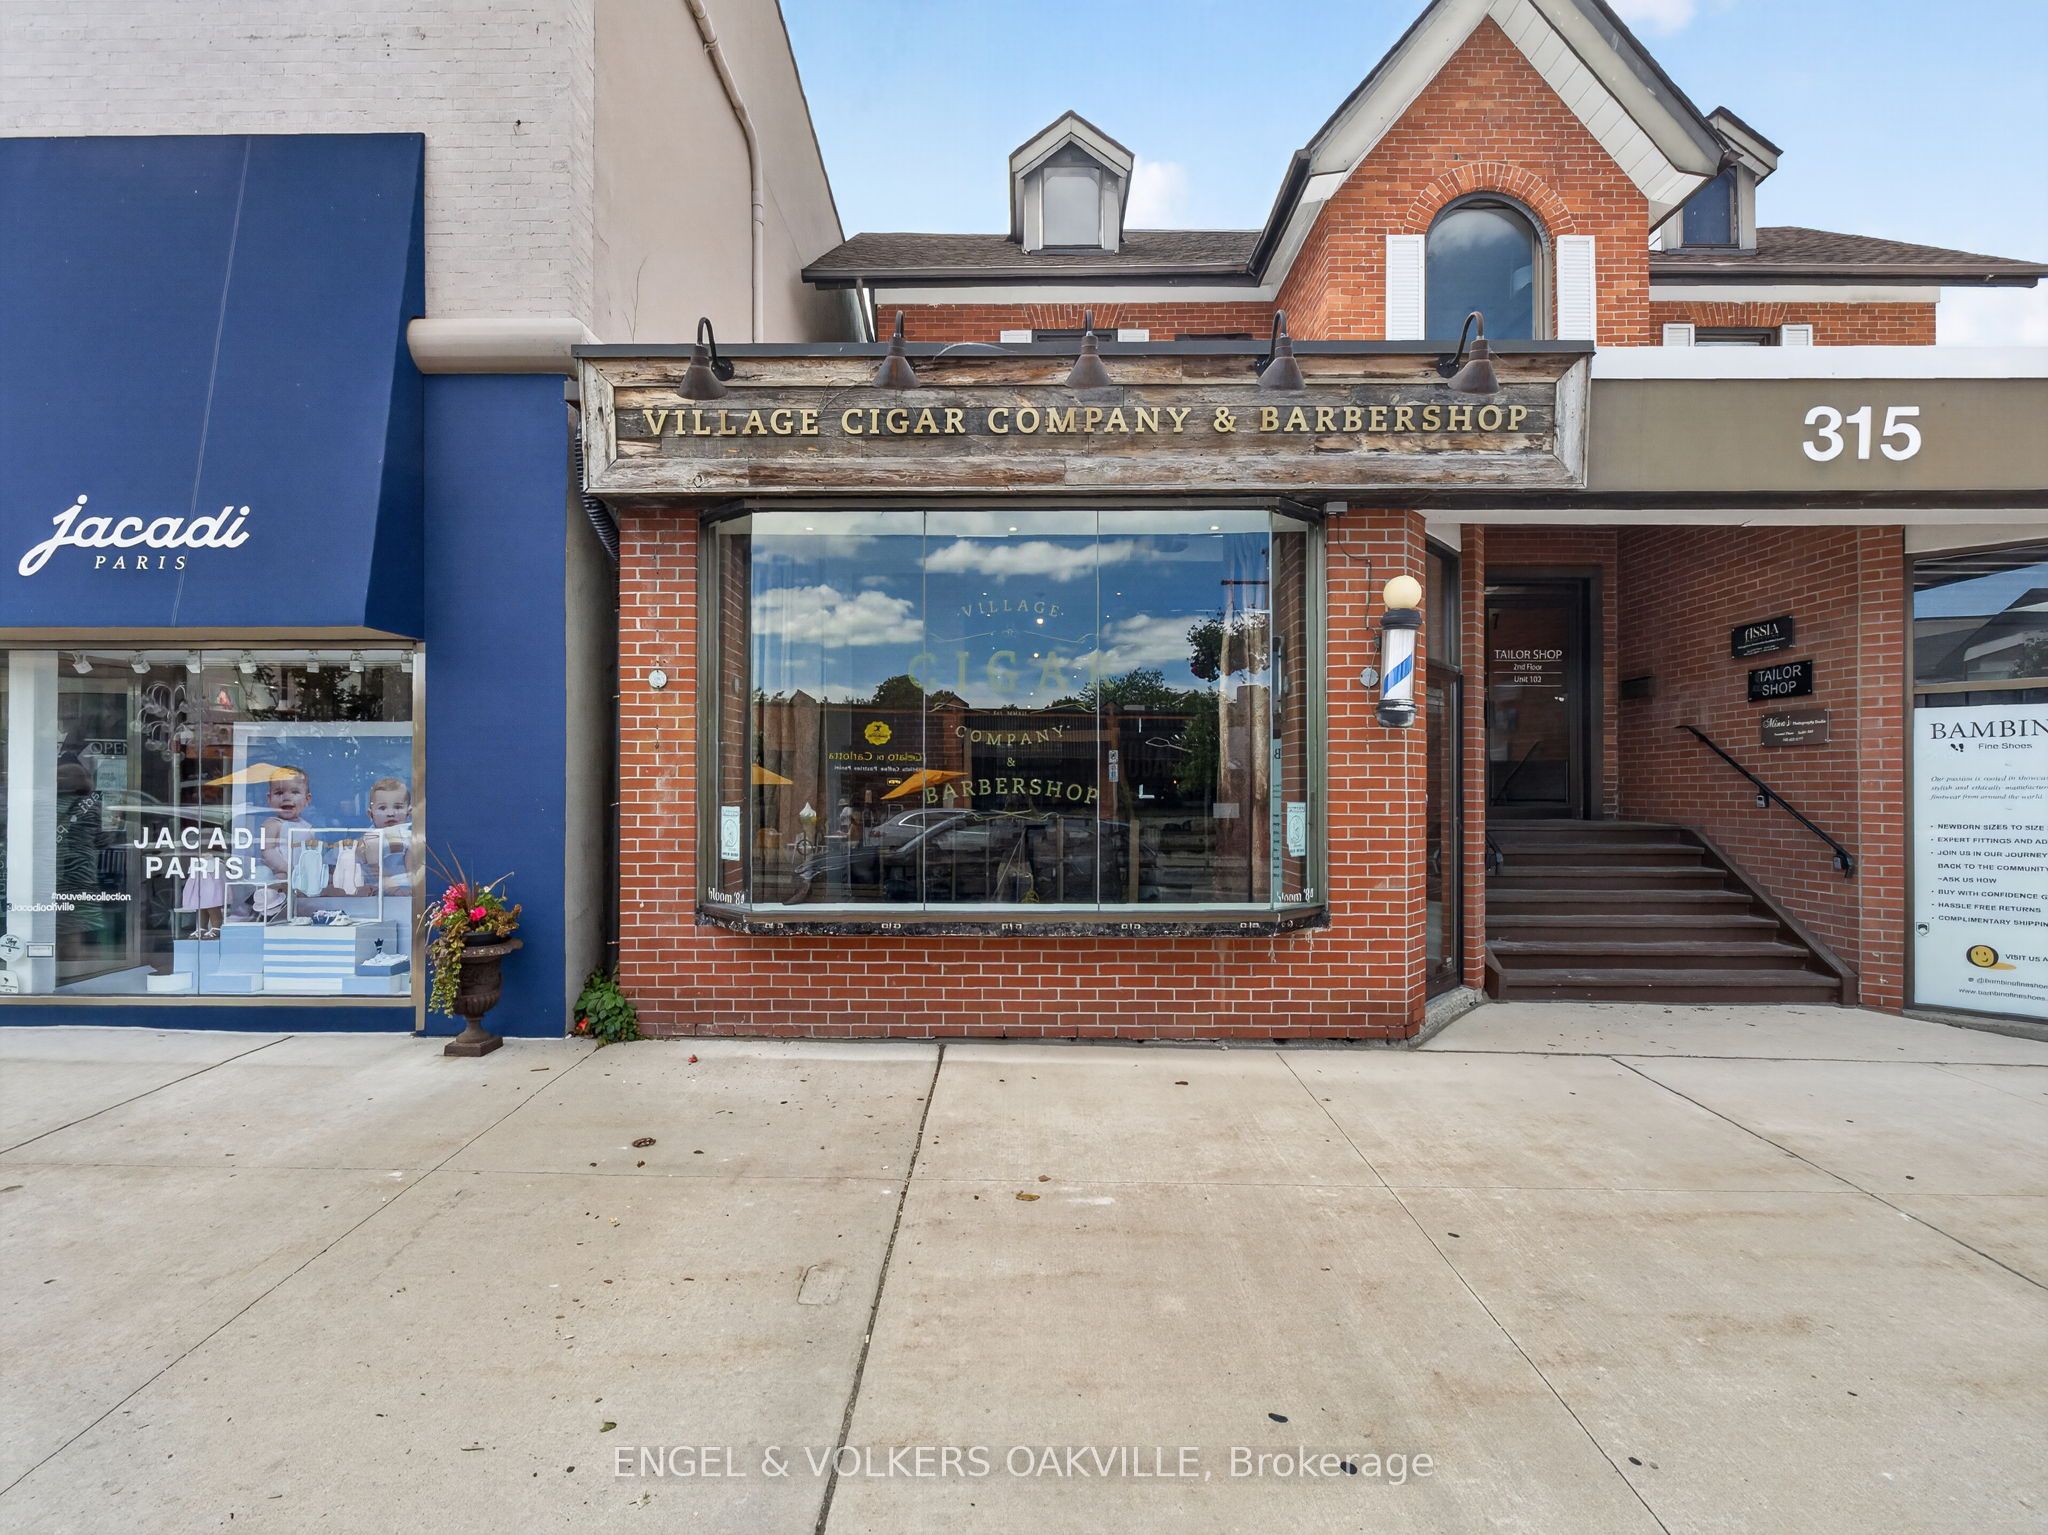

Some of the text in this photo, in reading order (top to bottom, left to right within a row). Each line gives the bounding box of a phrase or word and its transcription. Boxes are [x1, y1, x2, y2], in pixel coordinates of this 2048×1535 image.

[643, 405, 1528, 436] VILLAGE CIGAR COMPANY & BARBERSHOP
[1802, 405, 1922, 462] 315
[18, 494, 251, 577] jacadi
[94, 555, 187, 570] PARIS
[961, 600, 1061, 617] VILLAGE
[1494, 649, 1563, 660] TAILOR SHOP
[1758, 664, 1802, 682] TAILOR
[1762, 681, 1797, 696] SHOP
[956, 724, 1063, 746] COMPANY
[1930, 719, 2048, 739] BAMBIN
[2001, 742, 2033, 750] Shoes
[1006, 757, 1016, 767] &
[925, 777, 1099, 805] BARBERSHOP
[1937, 823, 1981, 831] NEWBORN
[133, 826, 266, 850] JACADI
[145, 856, 257, 880] PARIS!
[1978, 863, 1994, 871] THE
[1996, 864, 2048, 872] COMMUNITY
[1981, 891, 2038, 899] CONFIDENCE
[1938, 902, 2042, 913] HASSLE FREE RETURNS
[1938, 915, 2011, 926] COMPLIMENTARY
[2005, 953, 2027, 961] VISIT
